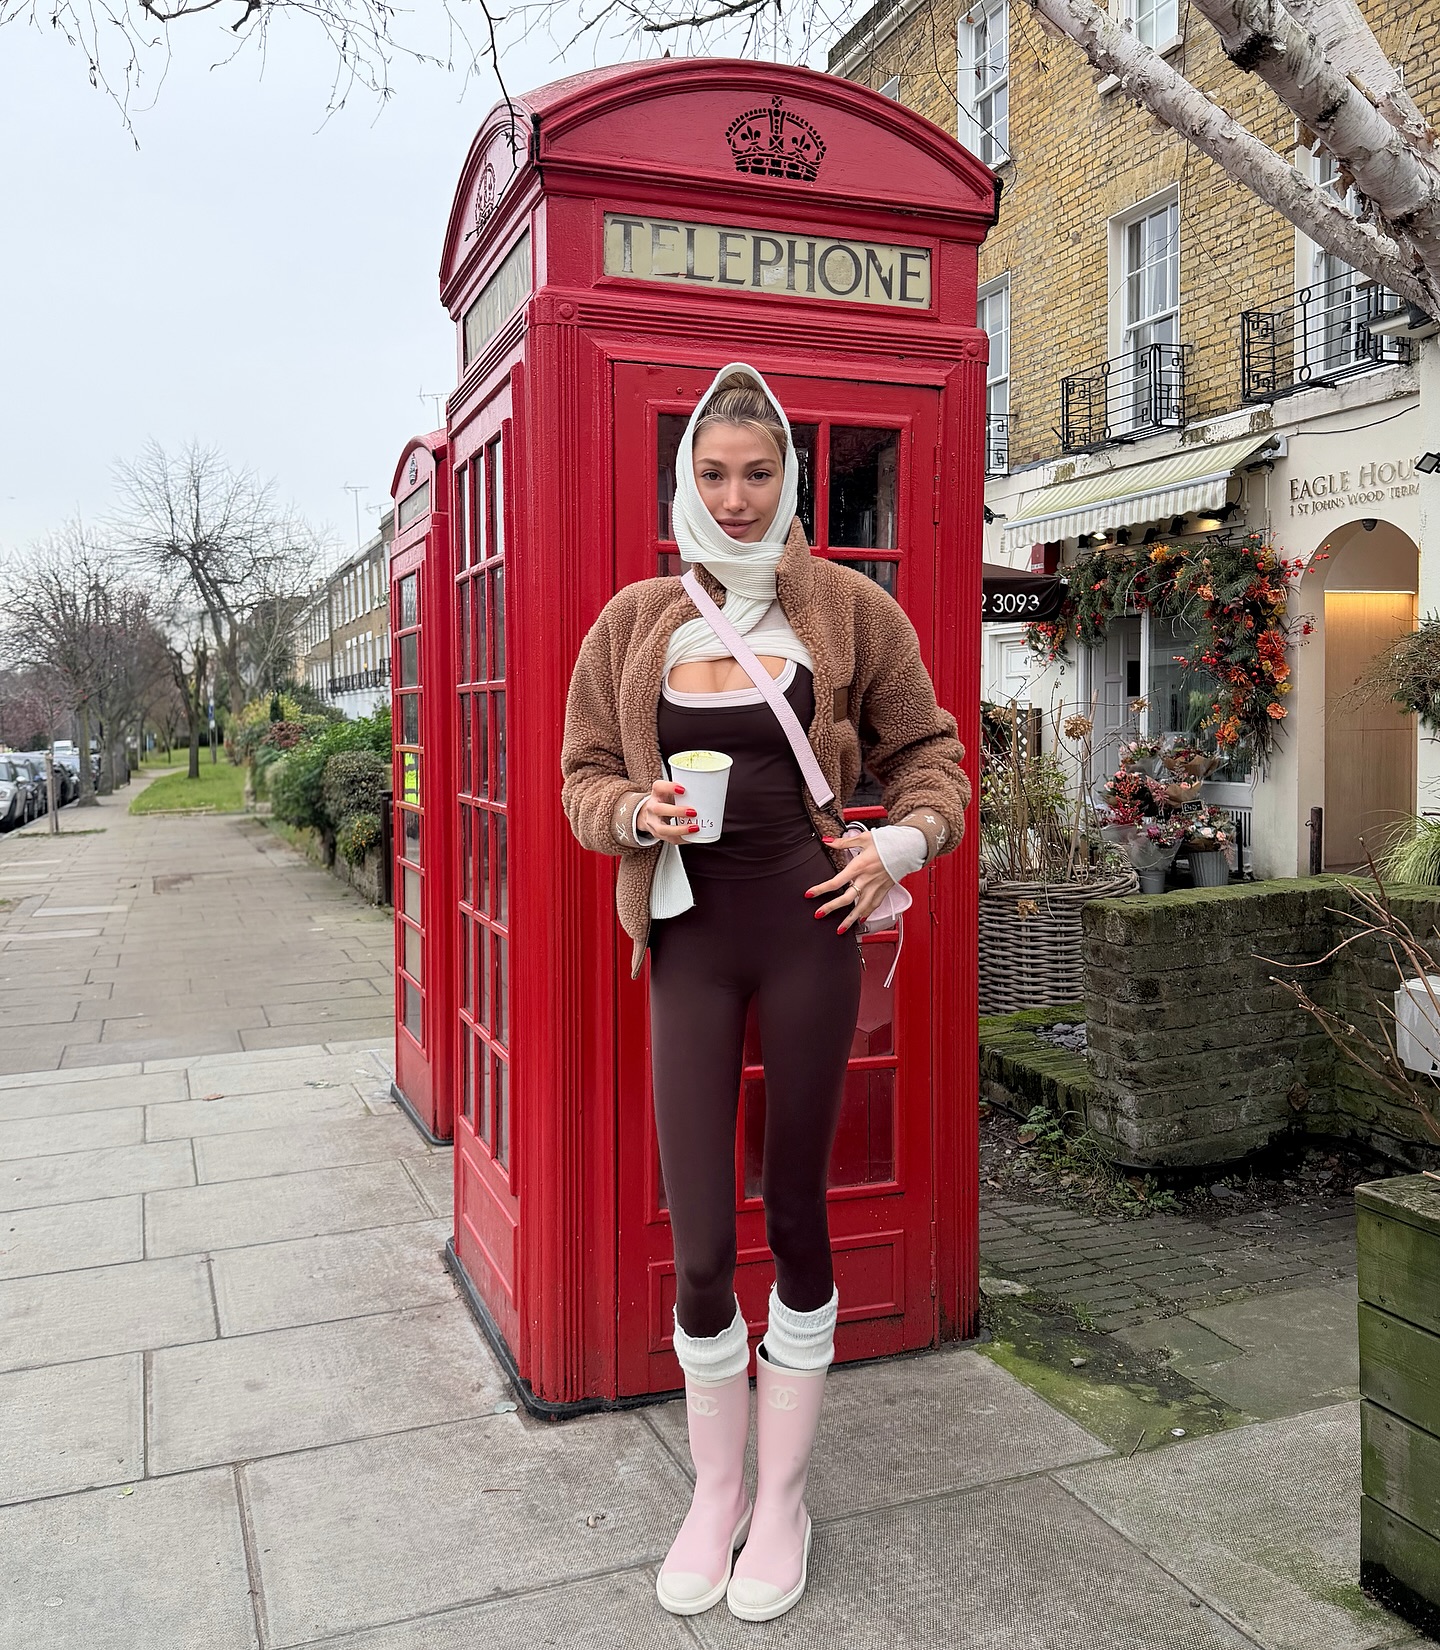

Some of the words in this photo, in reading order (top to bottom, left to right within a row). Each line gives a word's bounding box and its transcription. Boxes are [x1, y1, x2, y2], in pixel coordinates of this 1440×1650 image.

[609, 218, 927, 304] TELEPHONE
[1289, 470, 1350, 500] EAGLE
[1297, 503, 1309, 515] ST
[1347, 490, 1385, 506] WOOD
[992, 594, 1039, 613] 3093
